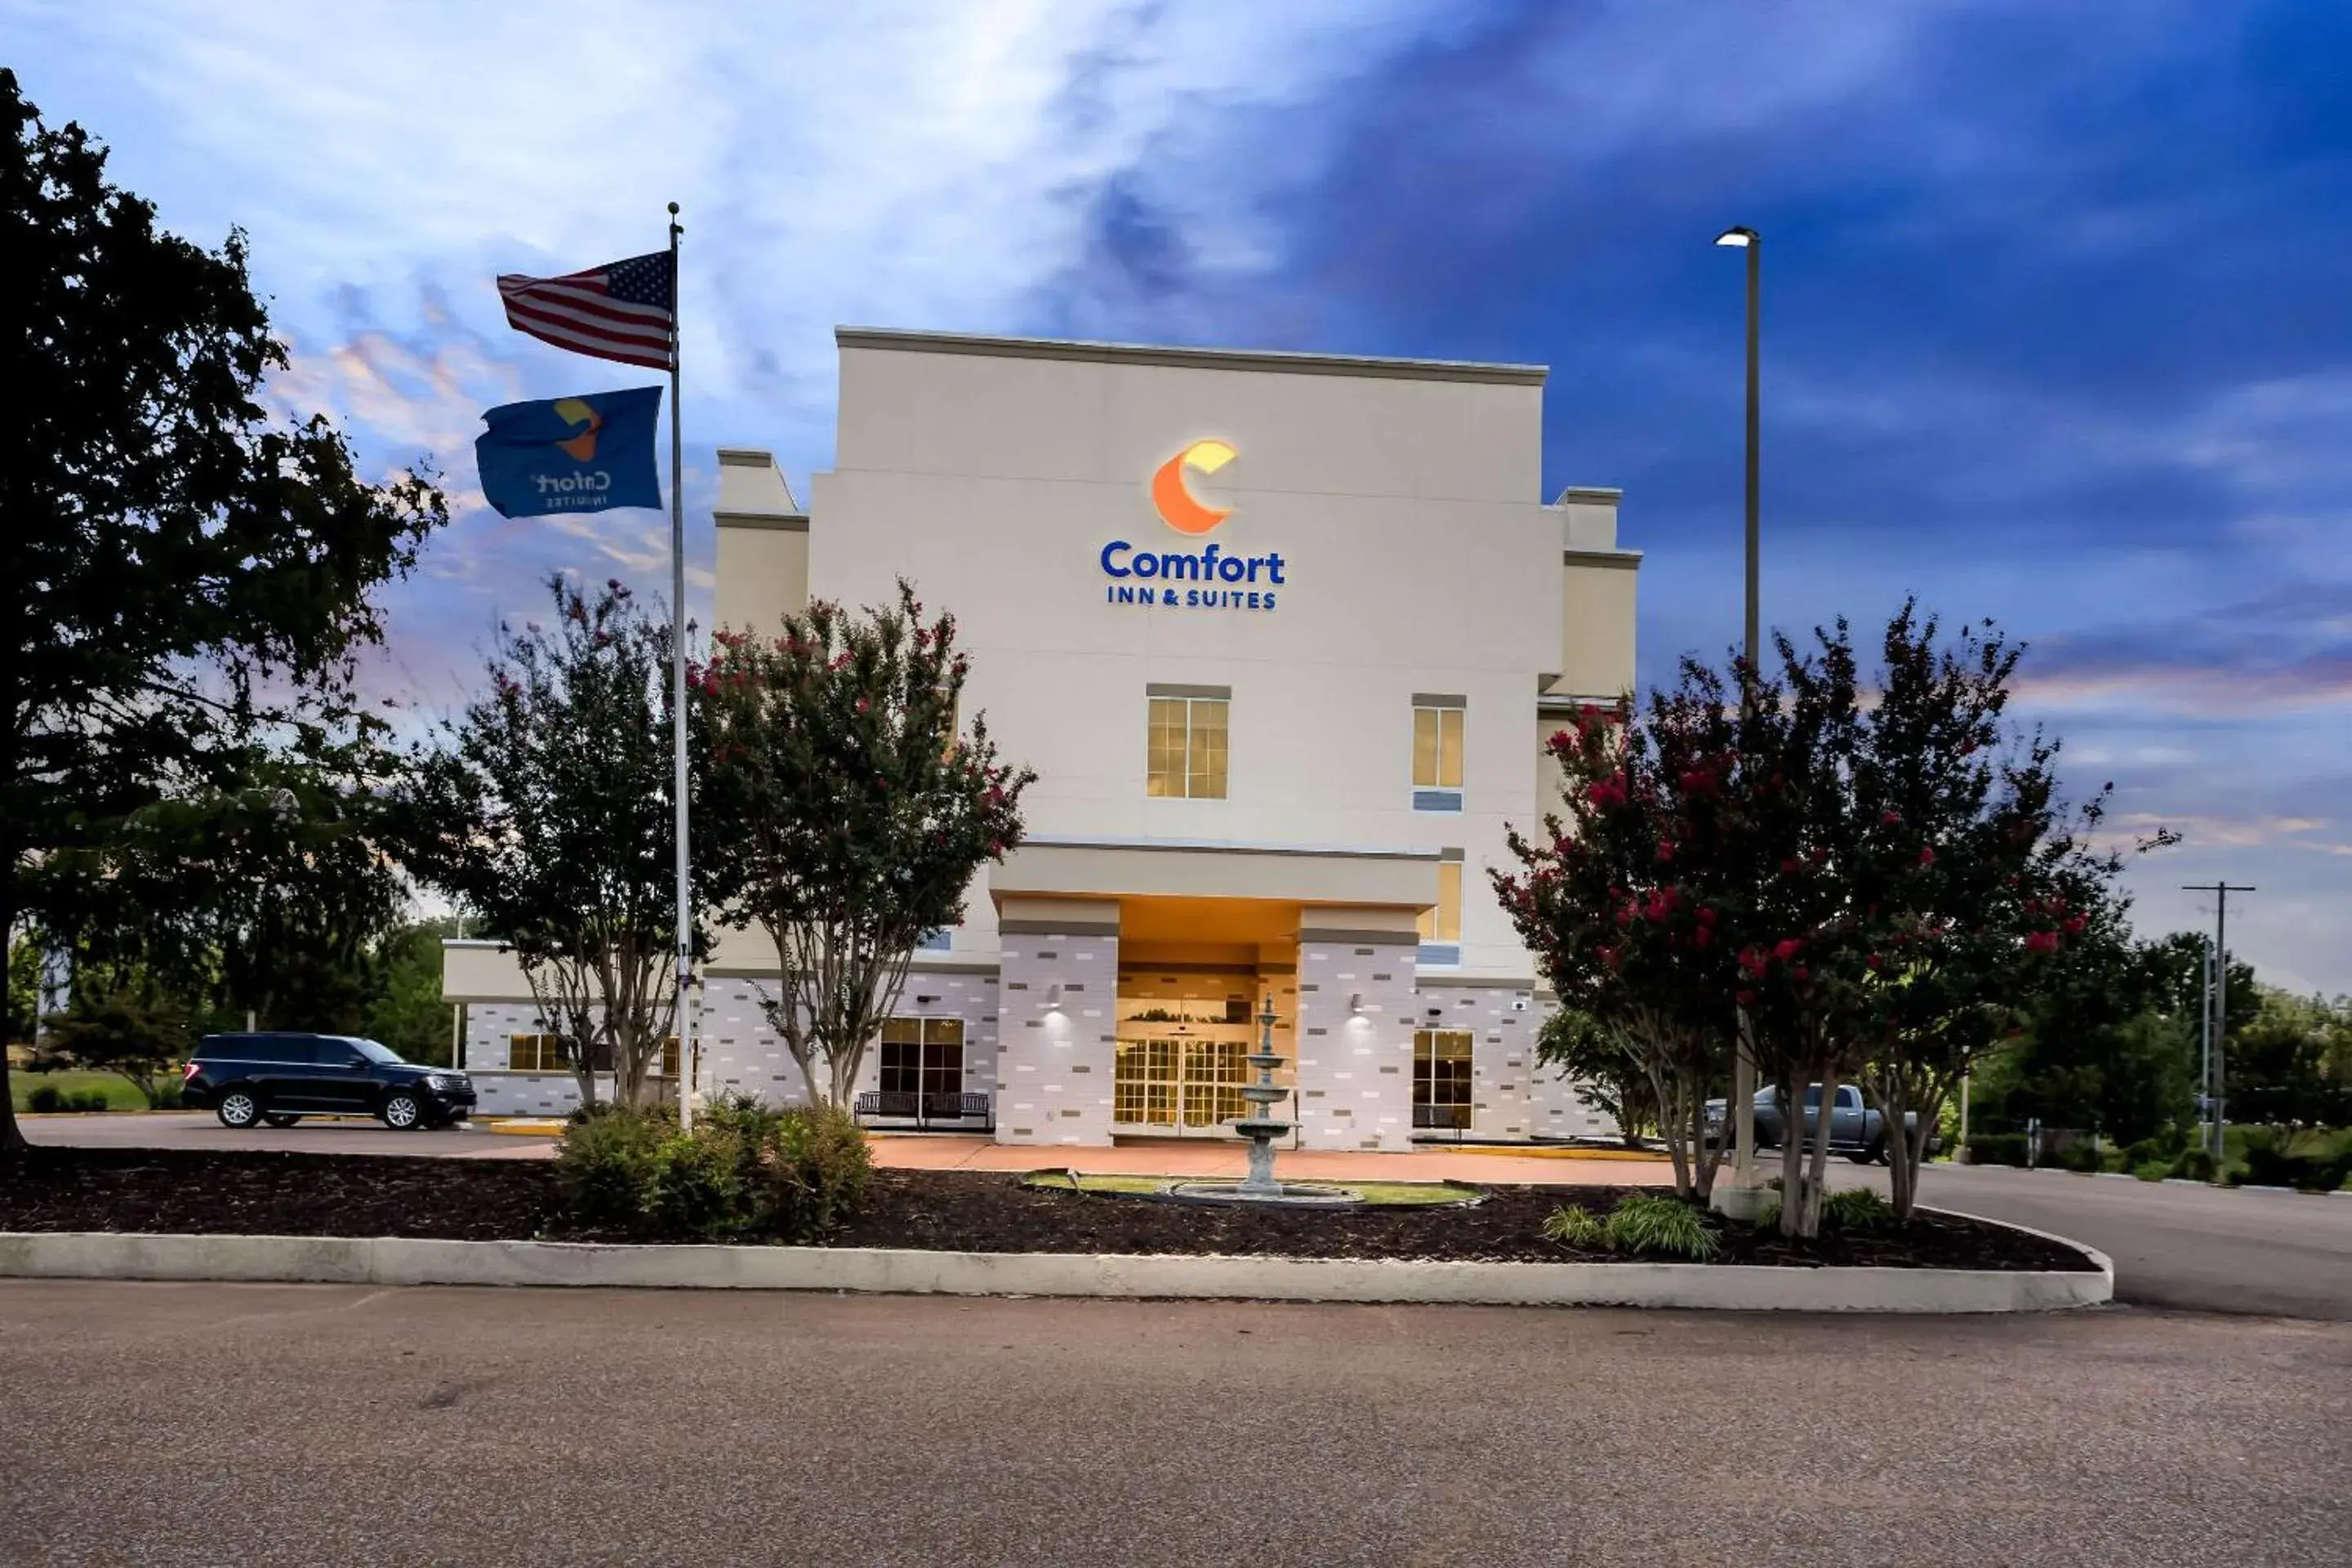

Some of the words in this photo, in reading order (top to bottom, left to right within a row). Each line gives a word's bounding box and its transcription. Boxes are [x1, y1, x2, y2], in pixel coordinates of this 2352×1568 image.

[1100, 540, 1285, 584] Comfort
[1107, 586, 1155, 605] INN
[1162, 588, 1180, 606] &
[1187, 590, 1276, 609] SUITES
